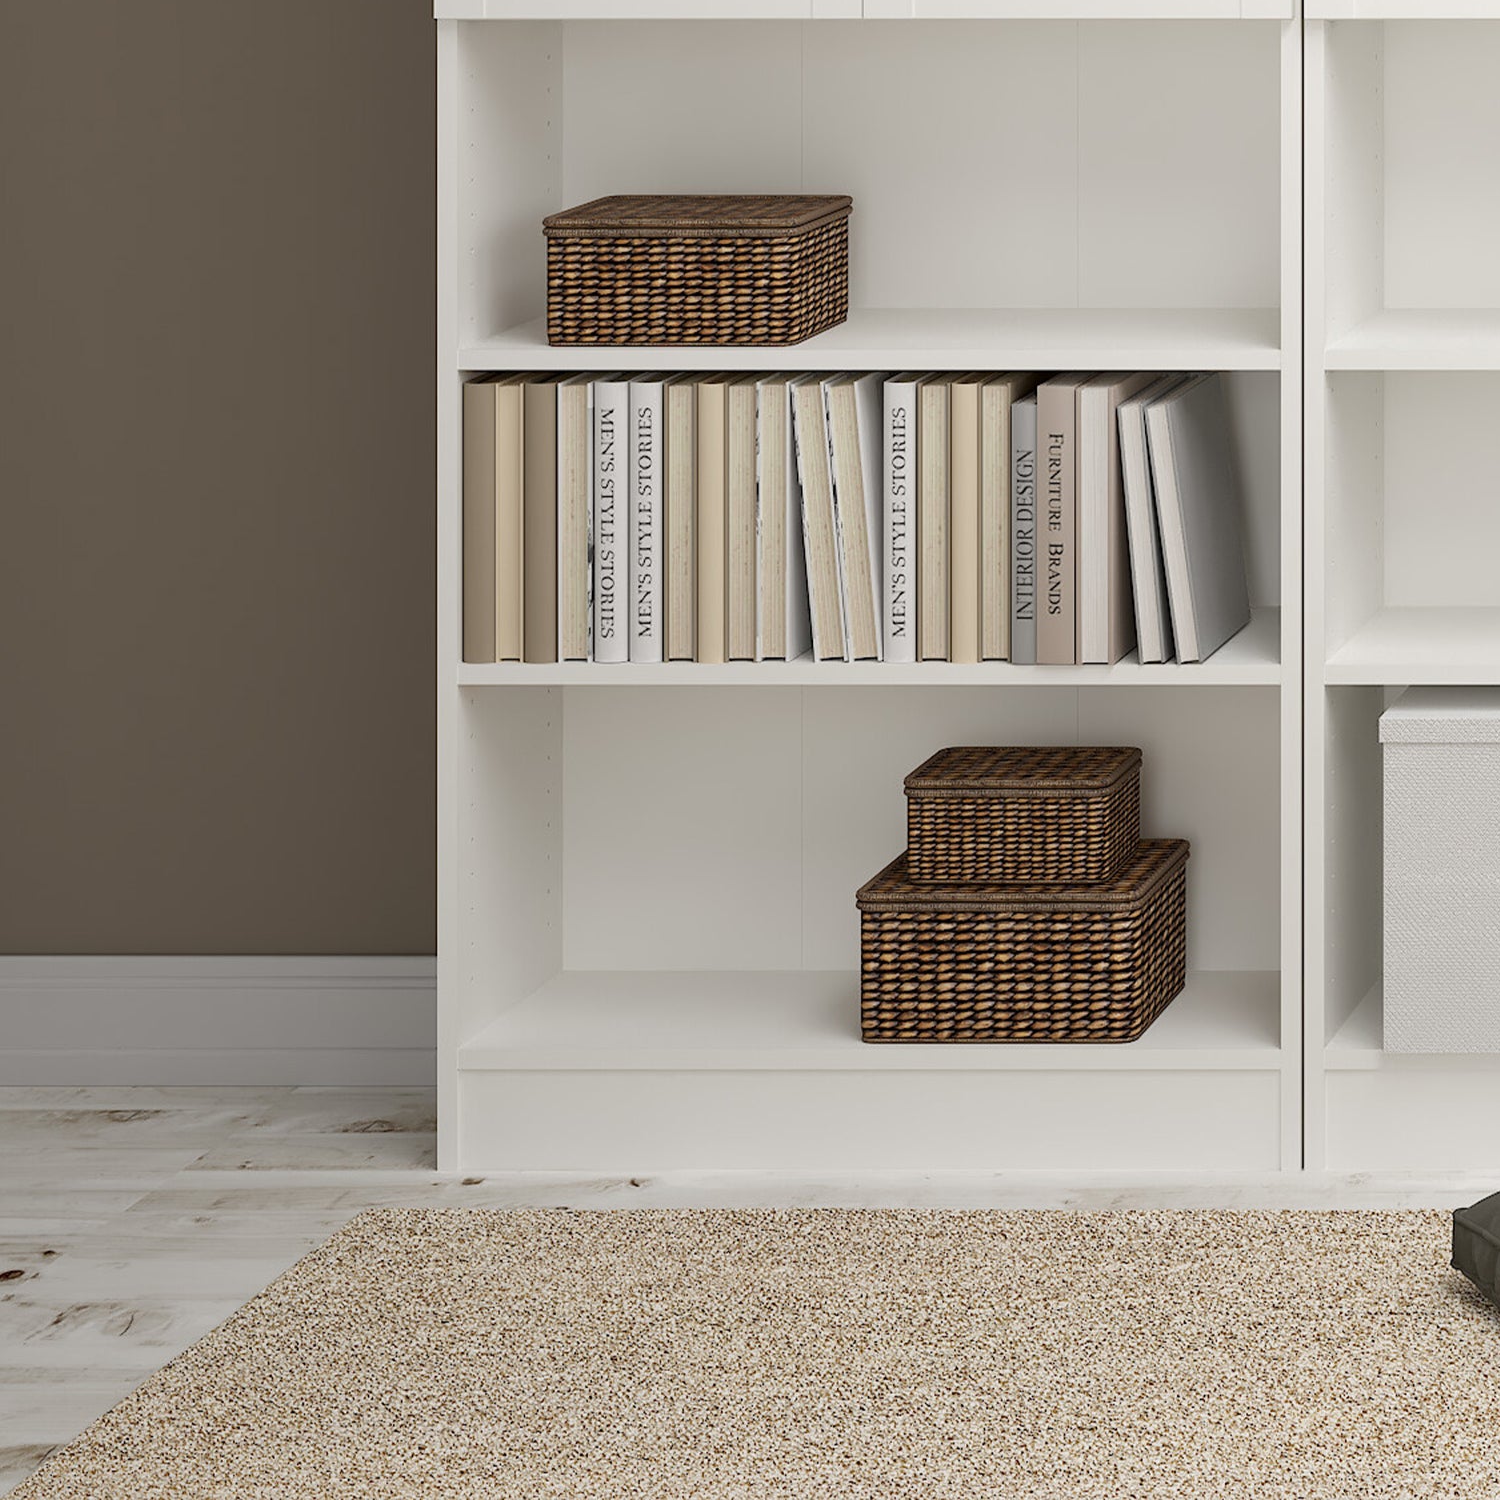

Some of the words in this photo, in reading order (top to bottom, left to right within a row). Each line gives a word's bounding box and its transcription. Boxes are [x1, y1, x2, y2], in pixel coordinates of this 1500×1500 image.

[600, 408, 616, 473] MEN'S
[637, 406, 653, 496] STORIES
[890, 406, 907, 496] STORIES
[600, 478, 616, 546] STYLE
[1015, 449, 1034, 522] DESIGN
[637, 501, 653, 568] STYLE
[890, 501, 907, 568] STYLE
[600, 549, 616, 639] STORIES
[637, 573, 653, 638] MEN'S
[890, 573, 907, 638] MEN'S
[1015, 527, 1034, 620] INTERIOR
